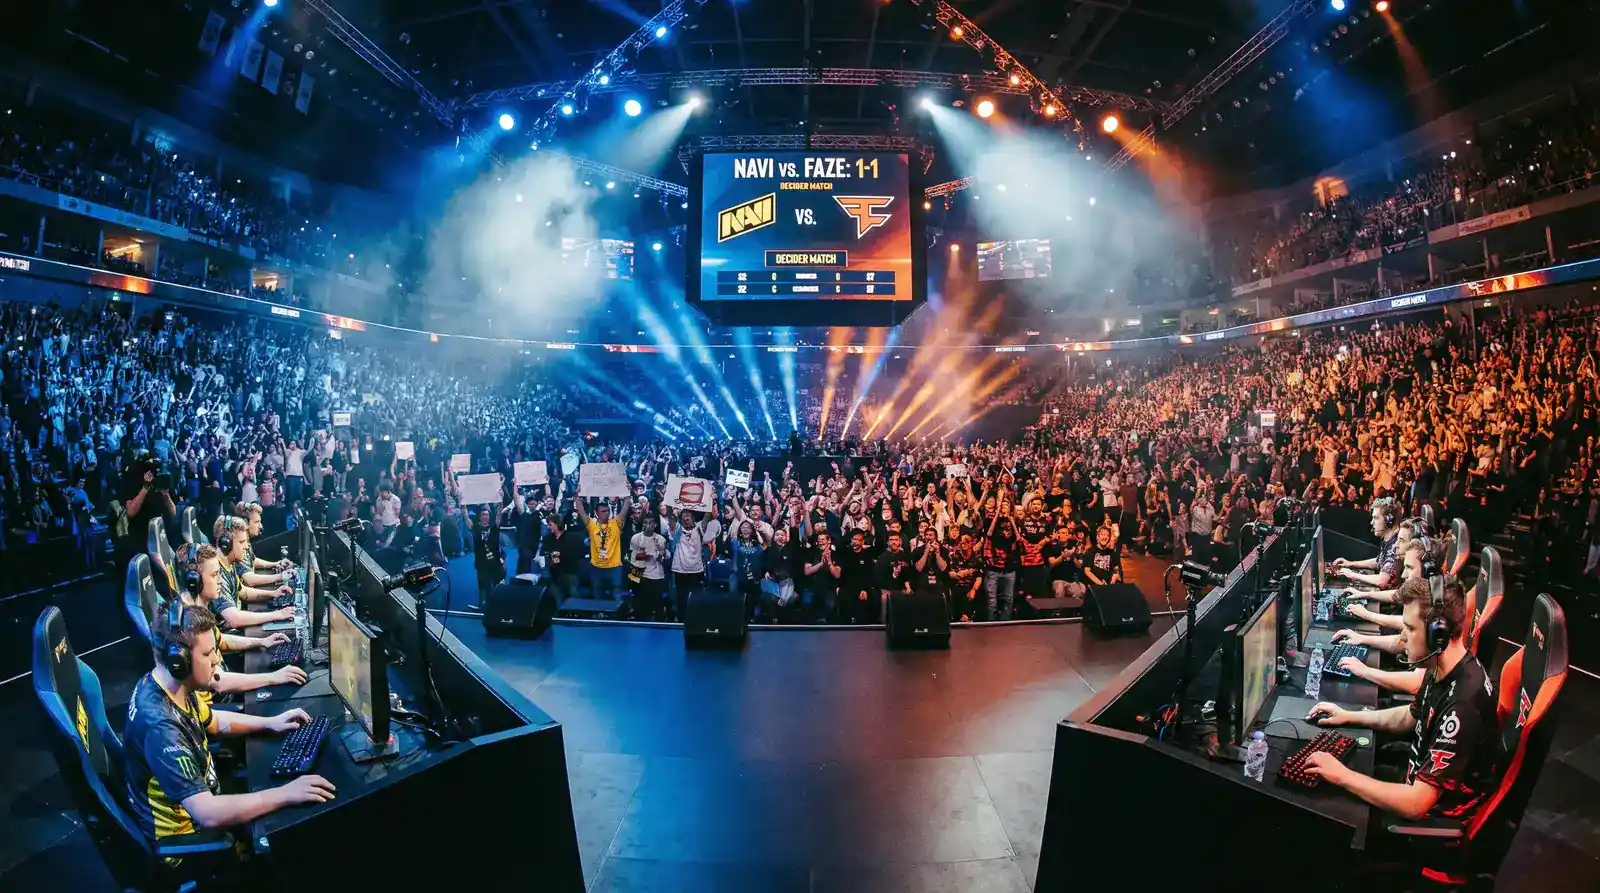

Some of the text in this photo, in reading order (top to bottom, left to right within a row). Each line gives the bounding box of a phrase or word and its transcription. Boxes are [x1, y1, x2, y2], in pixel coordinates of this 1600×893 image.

[734, 158, 774, 178] NAVI
[804, 157, 851, 178] FAZE:
[855, 158, 879, 178] 1-1
[780, 182, 833, 190] DECIDER MATCH
[795, 208, 817, 225] VS.
[775, 253, 837, 265] DECIDER MATCH
